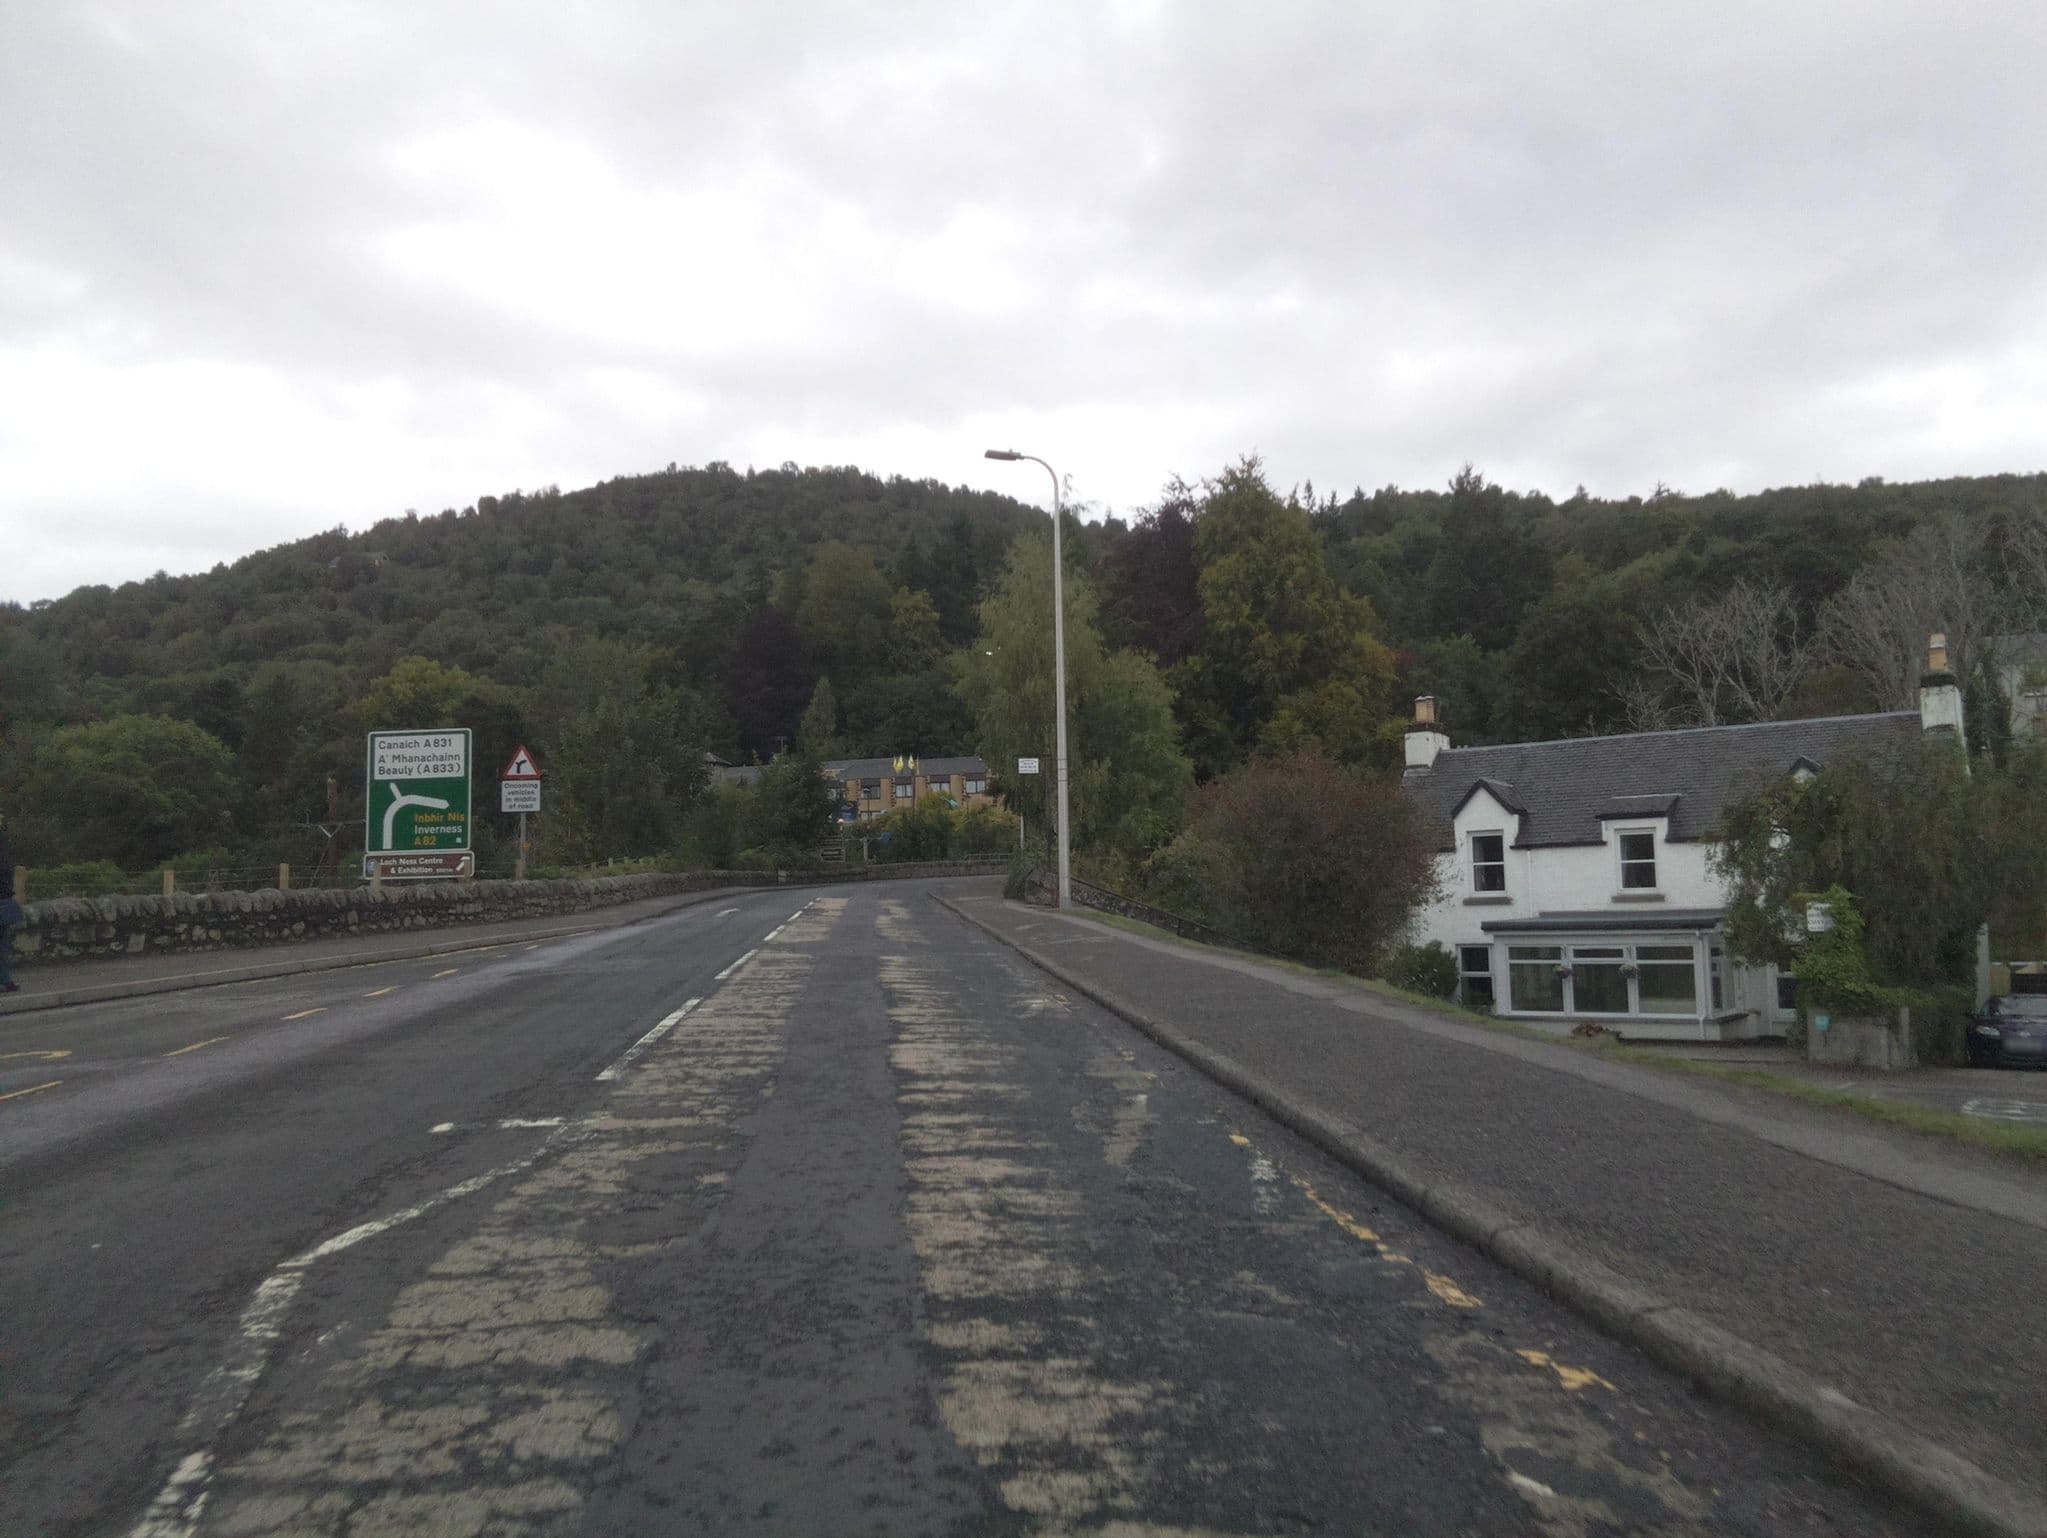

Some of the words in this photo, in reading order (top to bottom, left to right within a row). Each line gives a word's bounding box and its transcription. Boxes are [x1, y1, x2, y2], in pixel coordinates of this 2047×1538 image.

[378, 740, 420, 749] Canaich
[392, 753, 460, 763] Mhanachainn
[378, 766, 413, 775] Beauly
[415, 813, 443, 823] Inbhir
[448, 812, 465, 822] Nis
[415, 825, 462, 834] Inverness
[415, 836, 437, 845] A82
